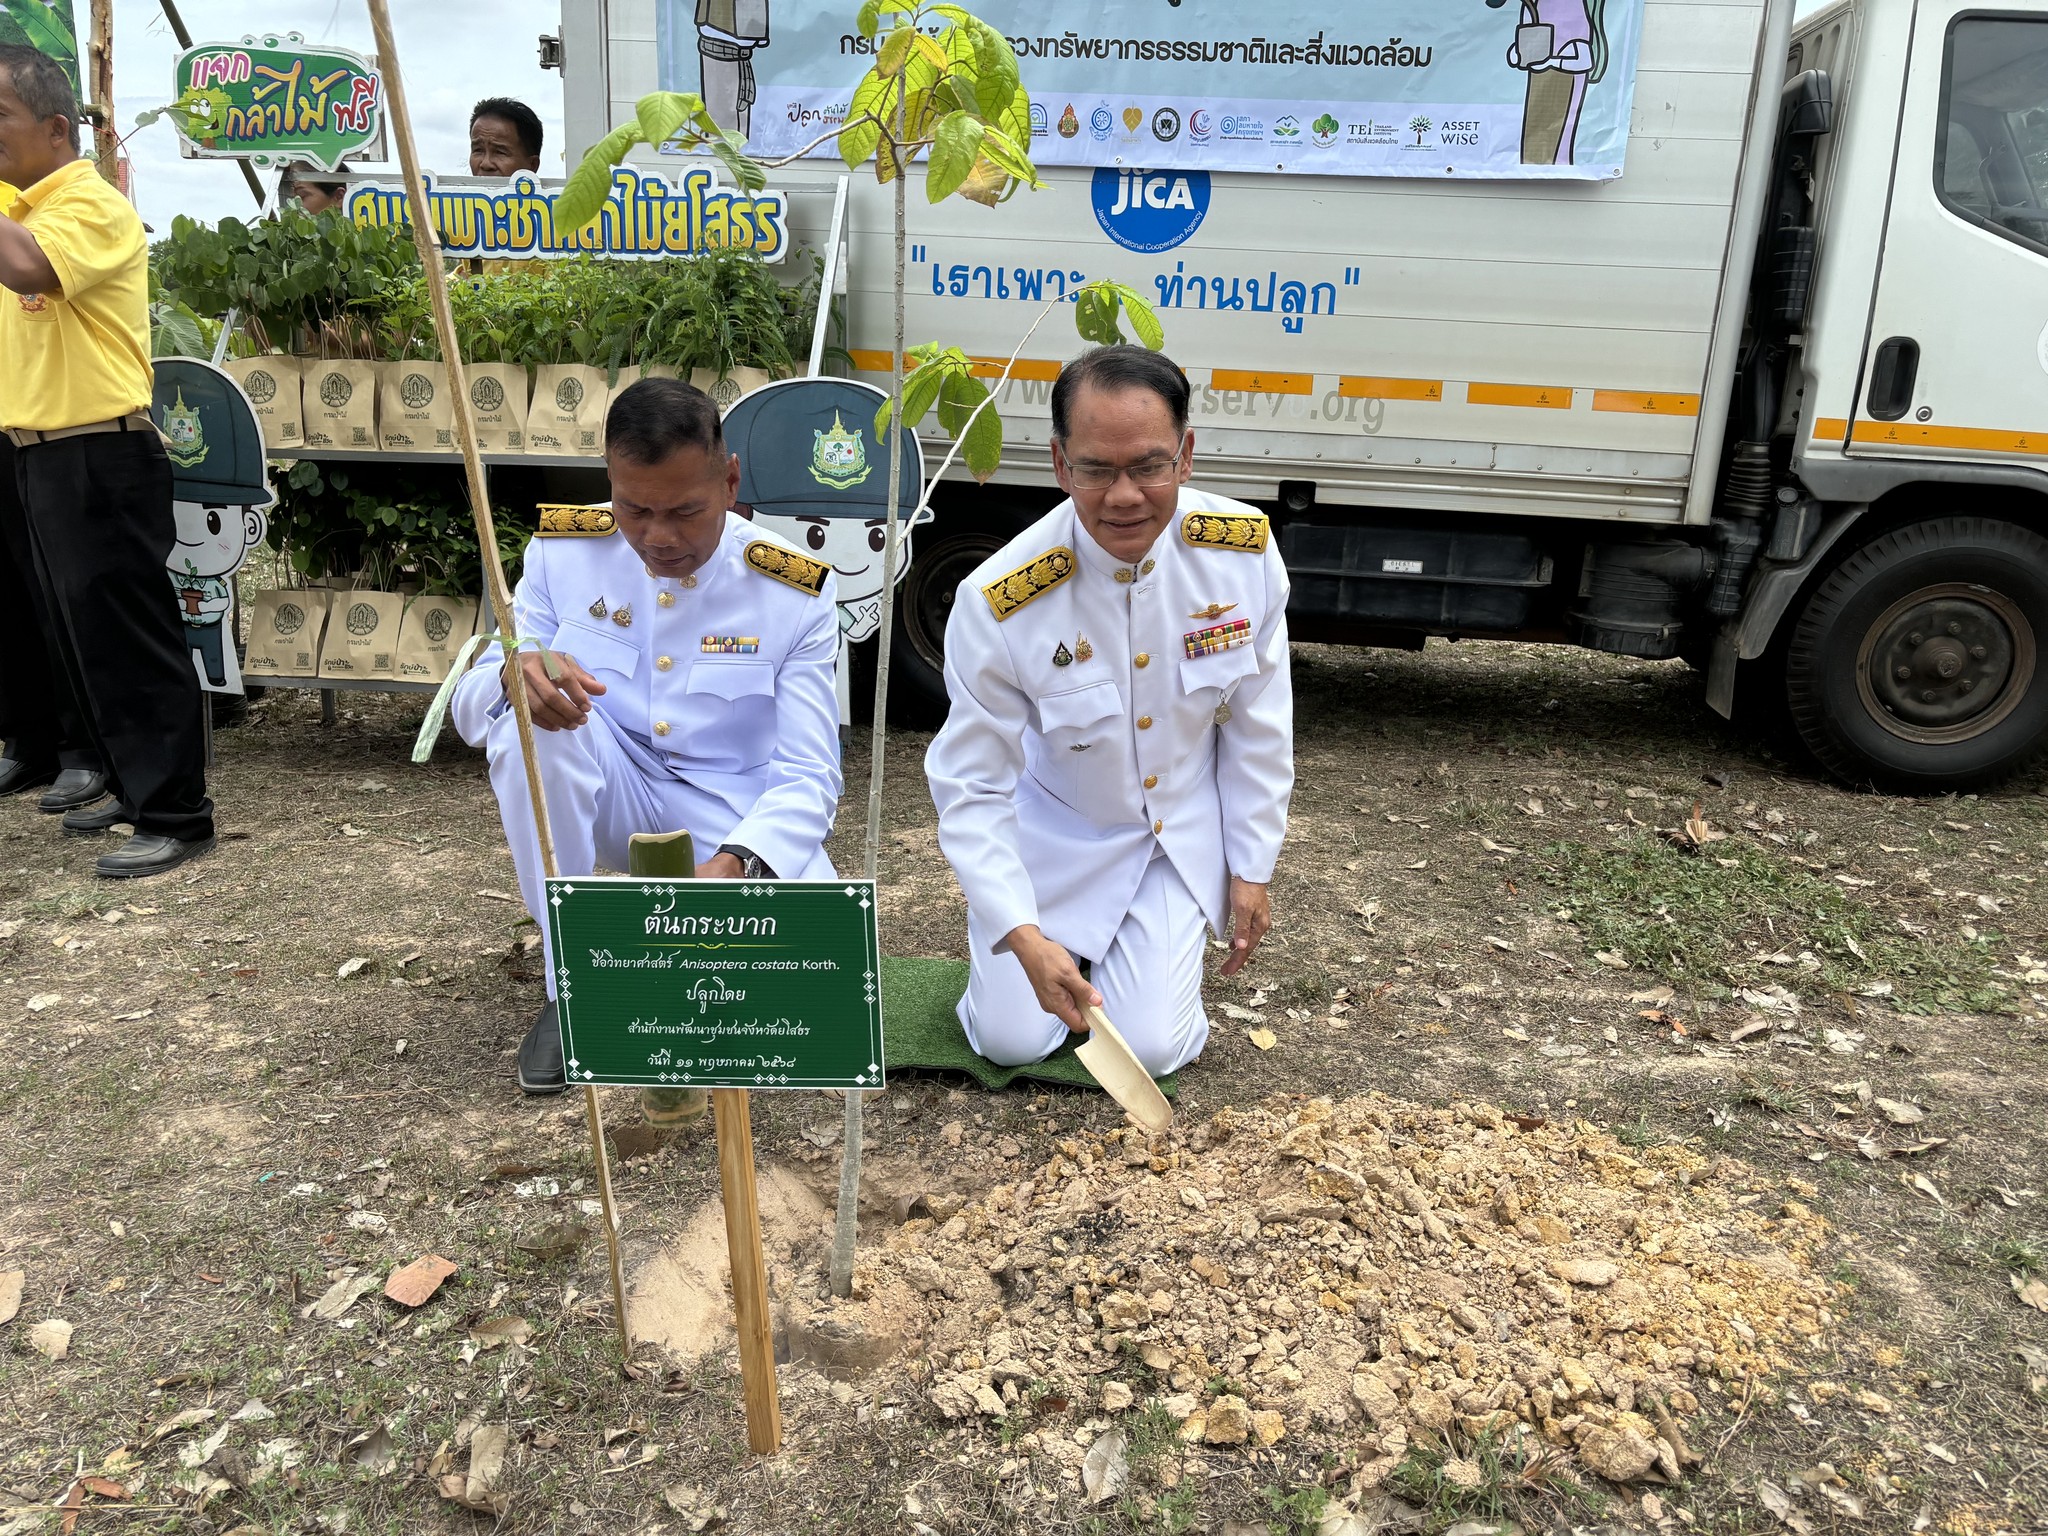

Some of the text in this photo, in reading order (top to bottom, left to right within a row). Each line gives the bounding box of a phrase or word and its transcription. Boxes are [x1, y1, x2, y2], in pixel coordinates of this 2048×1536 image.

[191, 53, 250, 89] แจก
[226, 60, 377, 139] กล้าไม้ ฟรี
[787, 103, 821, 127] ปลูก
[1442, 121, 1480, 131] ASSET
[1097, 208, 1203, 251] Japan International Cooperation Agency
[644, 896, 777, 936] ต้นกระบาก
[589, 949, 840, 972] ชื่อวิทยาศาสตร์ Anisoptera costata Korth.
[686, 976, 746, 1014] ปลูกโดย
[627, 1017, 811, 1043] สำนักงานพัฒนาชุมชนจังหวัดยโสธร
[647, 1048, 797, 1071] วันที่ ๑๑ พฤษภาคม ๒๕๖๘
